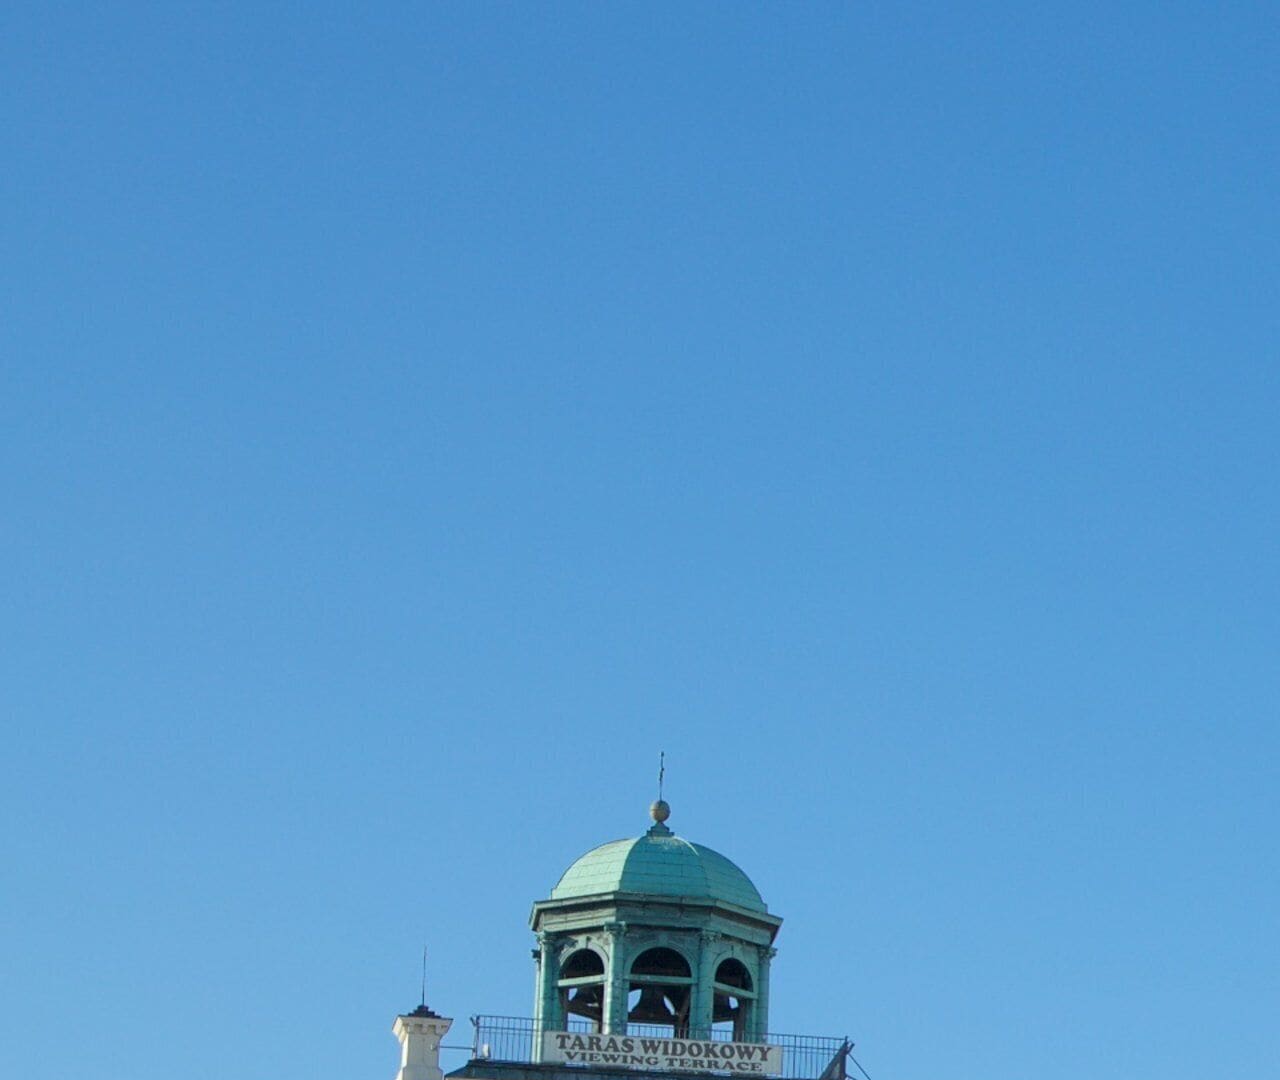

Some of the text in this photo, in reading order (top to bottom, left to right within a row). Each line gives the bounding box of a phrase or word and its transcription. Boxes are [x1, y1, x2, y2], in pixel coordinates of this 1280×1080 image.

[556, 1034, 772, 1061] TARAS WIDOKOWY
[565, 1051, 763, 1072] VIEWING TERRACE
